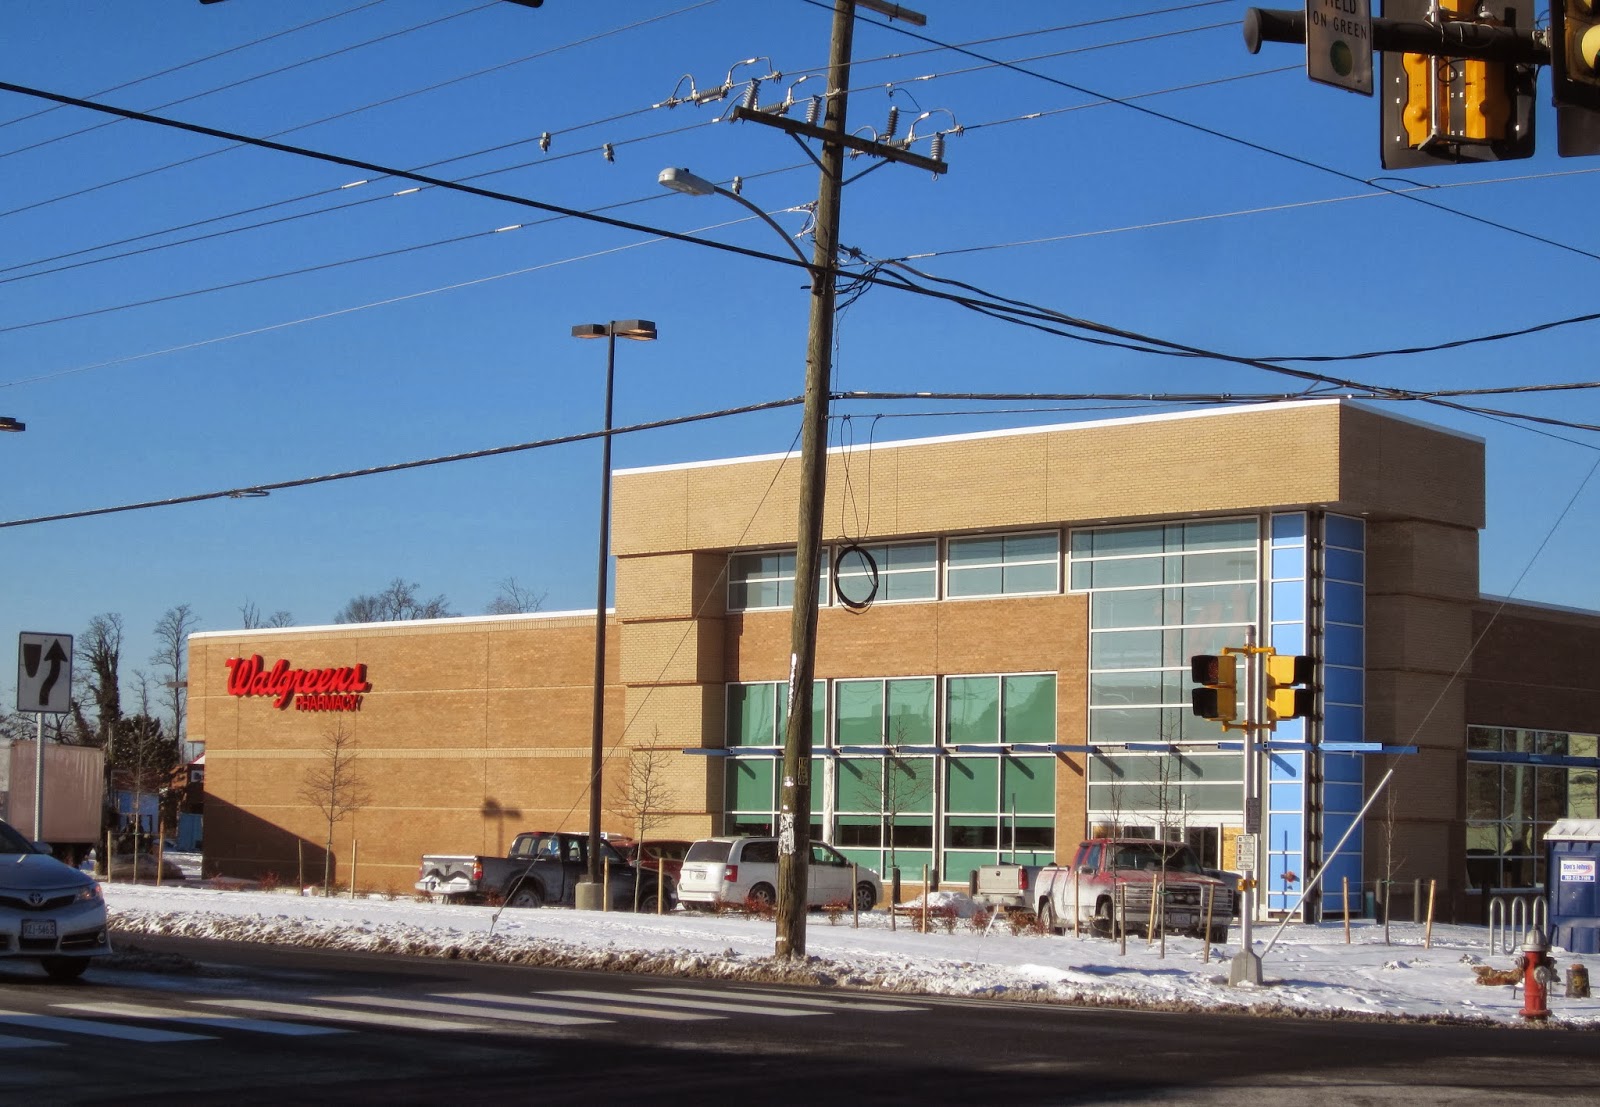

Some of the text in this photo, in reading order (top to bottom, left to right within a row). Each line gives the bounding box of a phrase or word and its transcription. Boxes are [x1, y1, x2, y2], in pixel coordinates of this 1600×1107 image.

[1313, 11, 1367, 39] ON GREEN
[225, 653, 369, 709] Walgreens
[295, 694, 361, 711] PHARMACY
